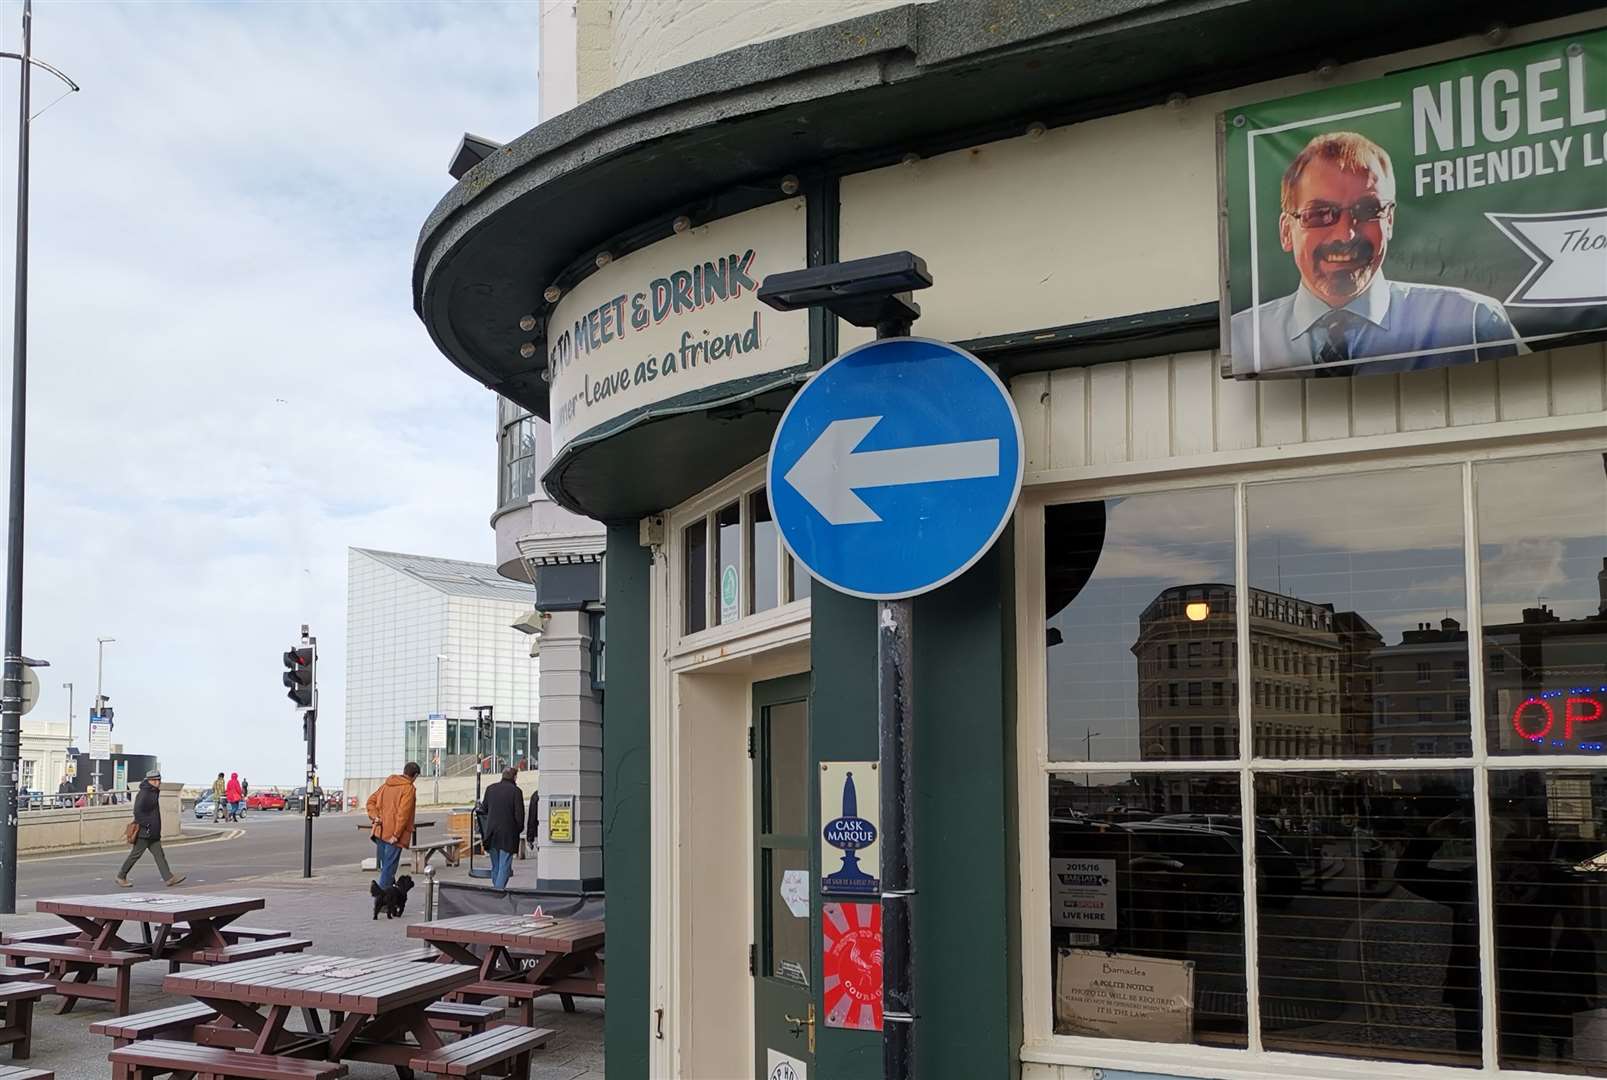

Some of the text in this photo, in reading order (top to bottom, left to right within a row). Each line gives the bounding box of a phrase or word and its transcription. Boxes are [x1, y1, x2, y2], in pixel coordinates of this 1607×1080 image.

[1413, 53, 1606, 156] NIGEL
[1415, 136, 1573, 197] FRIENDLY
[1560, 227, 1607, 254] Tho
[557, 329, 573, 374] TO
[574, 294, 628, 360] MEET
[631, 292, 650, 332] &
[650, 248, 759, 326] DRINK
[634, 355, 659, 387] as
[661, 351, 678, 378] a
[679, 310, 762, 370] friend
[1512, 696, 1605, 740] OP
[835, 820, 864, 832] CASK
[827, 831, 874, 843] MARQUE
[1066, 863, 1100, 872] 2015/16
[1062, 911, 1105, 921] LIVE HERE
[521, 958, 539, 970] yo
[844, 980, 882, 1001] COURAG
[1099, 980, 1125, 989] POLITE
[1126, 983, 1155, 992] NOTICE
[1108, 992, 1127, 1000] WILL
